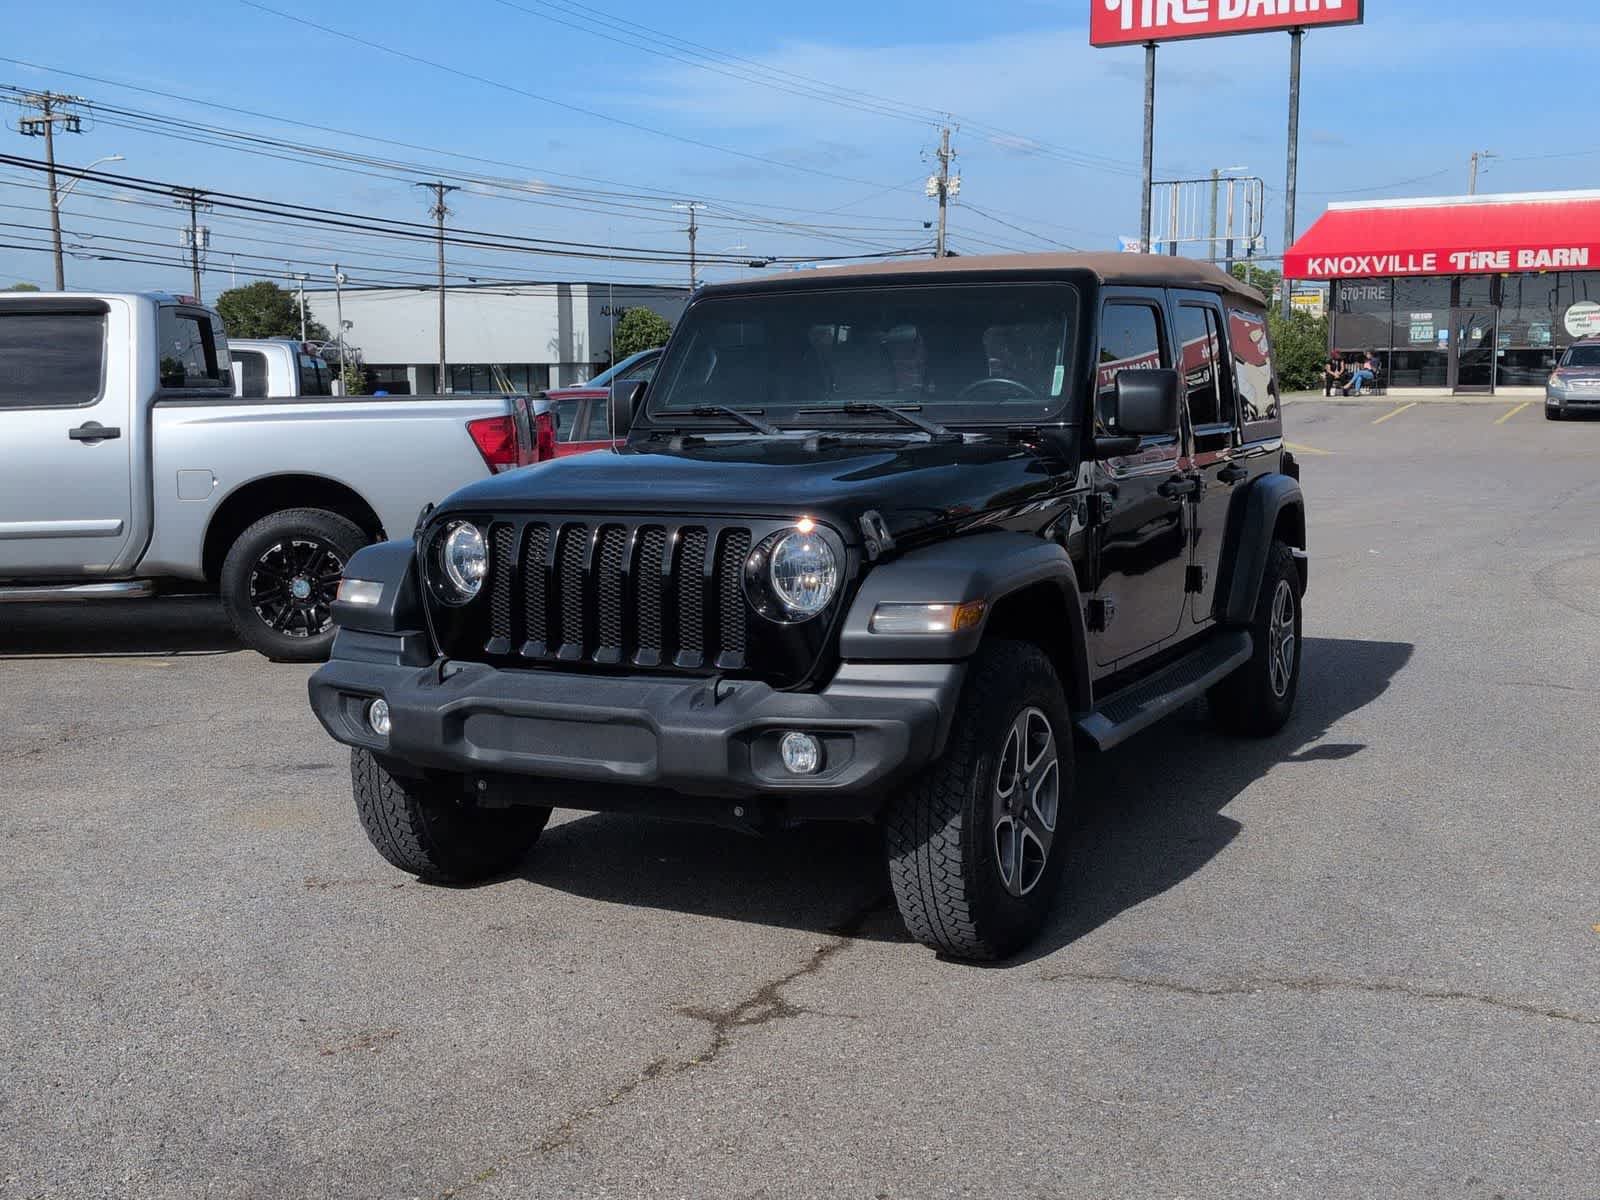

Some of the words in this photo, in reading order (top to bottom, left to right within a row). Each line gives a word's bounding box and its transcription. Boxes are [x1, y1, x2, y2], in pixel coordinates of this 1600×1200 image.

[1307, 253, 1438, 275] KNOXVILLE
[1517, 248, 1589, 268] BARN
[1341, 286, 1386, 301] 670-TIRE
